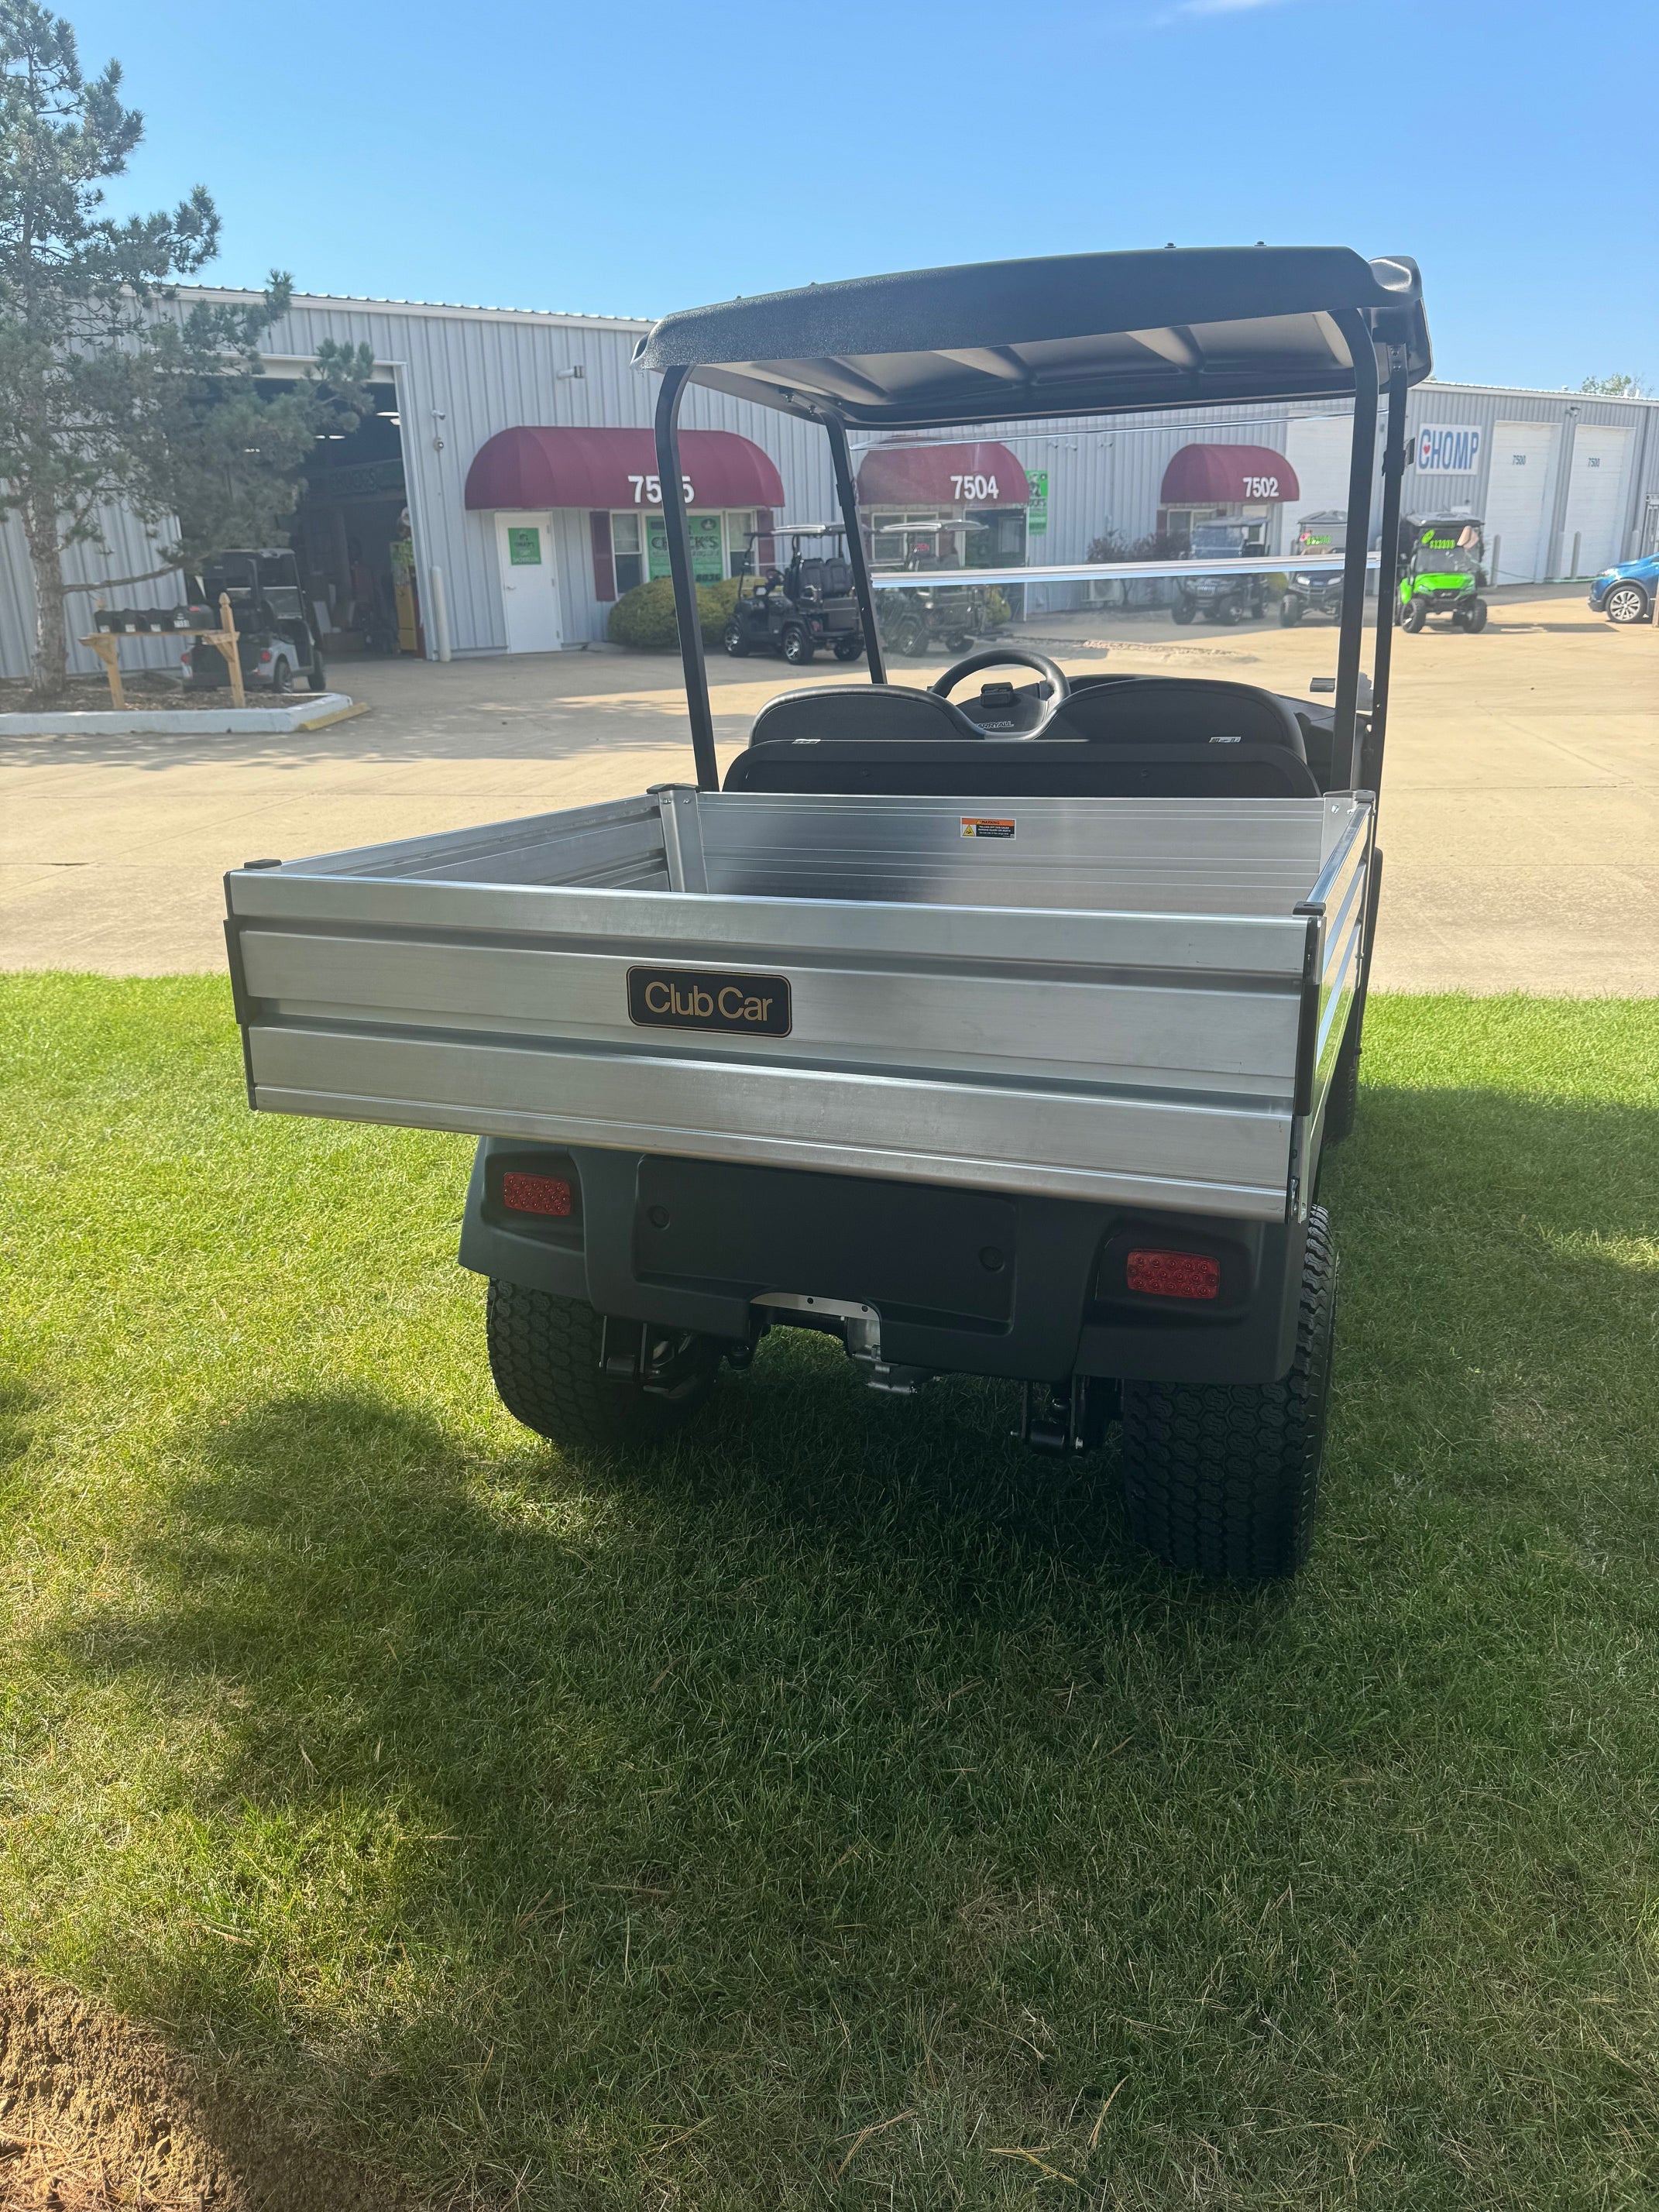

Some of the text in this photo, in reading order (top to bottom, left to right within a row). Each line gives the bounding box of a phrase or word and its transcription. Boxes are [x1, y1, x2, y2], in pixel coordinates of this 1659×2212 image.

[1419, 428, 1479, 470] CHOMP
[627, 475, 695, 503] 755
[950, 475, 999, 500] 7504
[1242, 476, 1279, 497] 7502
[974, 720, 1015, 729] ARRYALL
[644, 981, 773, 1022] Club Car
